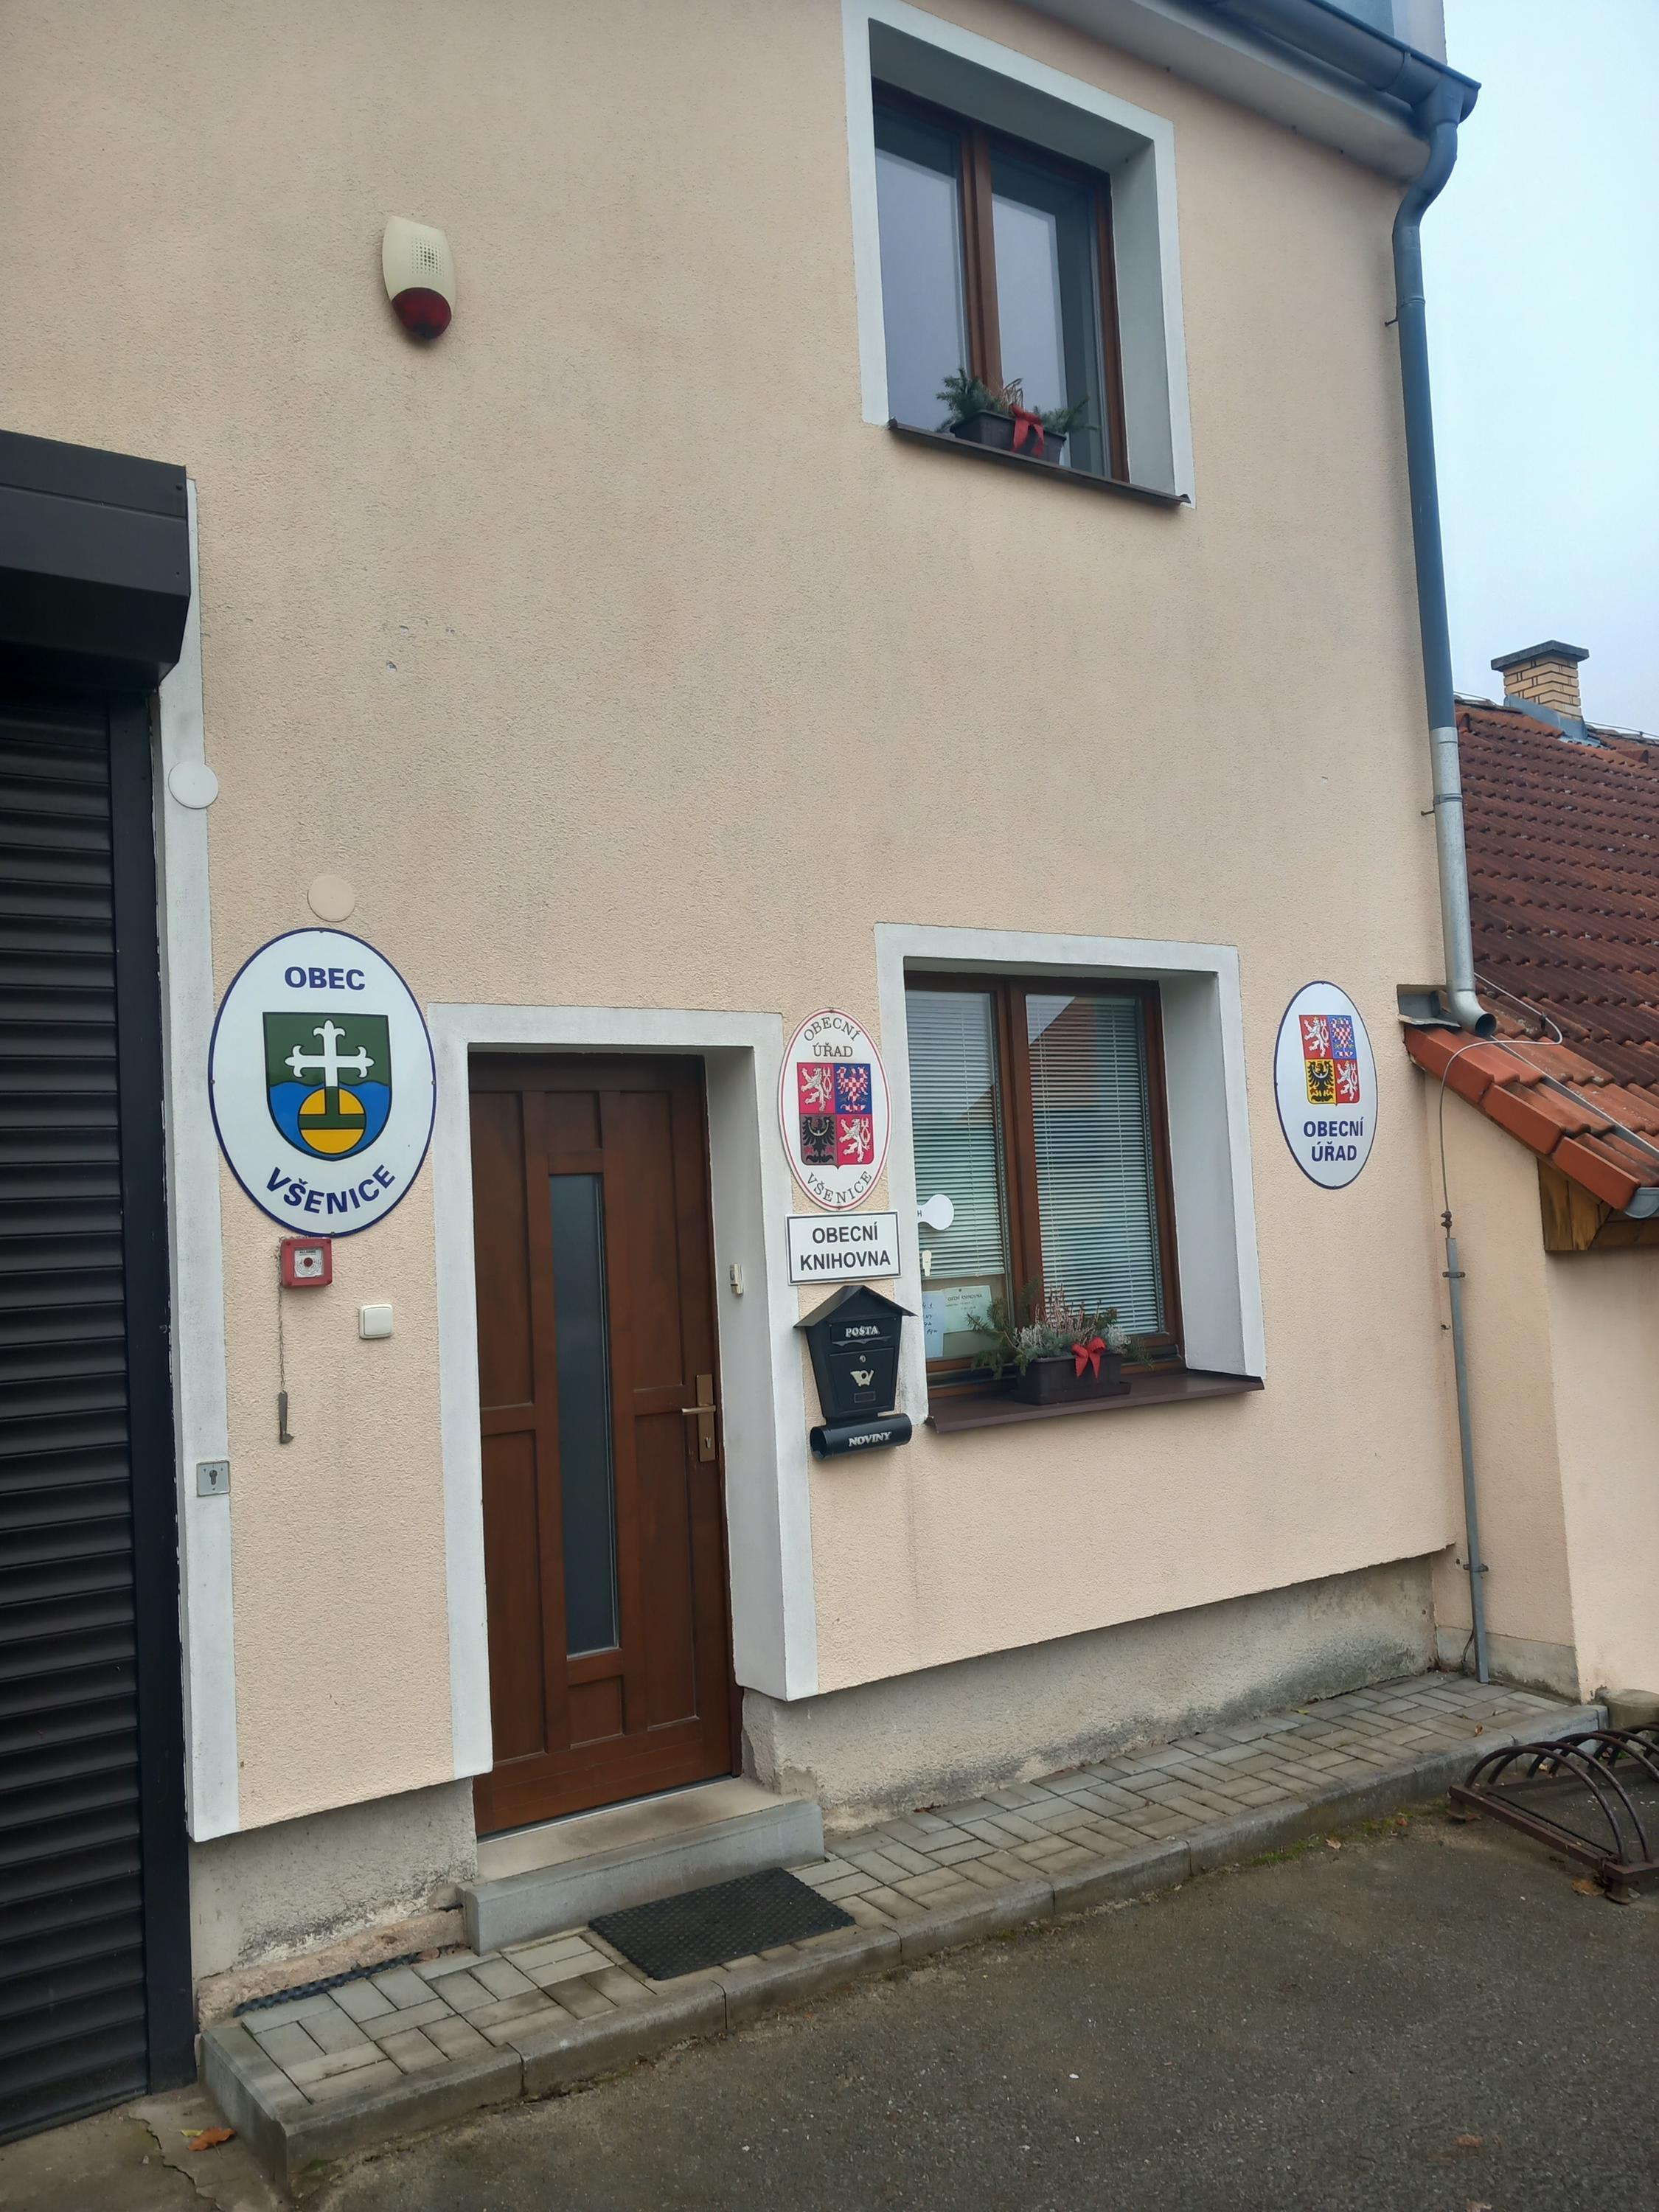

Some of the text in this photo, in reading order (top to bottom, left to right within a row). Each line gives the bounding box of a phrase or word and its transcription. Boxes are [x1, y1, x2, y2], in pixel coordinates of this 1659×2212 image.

[284, 966, 366, 991] OBEC
[804, 1017, 861, 1042] OBECNÍ
[813, 1042, 853, 1057] ÚŘAD
[1303, 1116, 1364, 1138] OBECNÍ
[1311, 1141, 1357, 1162] ÚŘAD
[266, 1164, 396, 1214] VŠENICE
[807, 1171, 872, 1203] VŠENICE
[812, 1221, 878, 1244] OBECNÍ
[800, 1250, 891, 1271] KNIHOVNA
[848, 1432, 892, 1447] NOVINY
